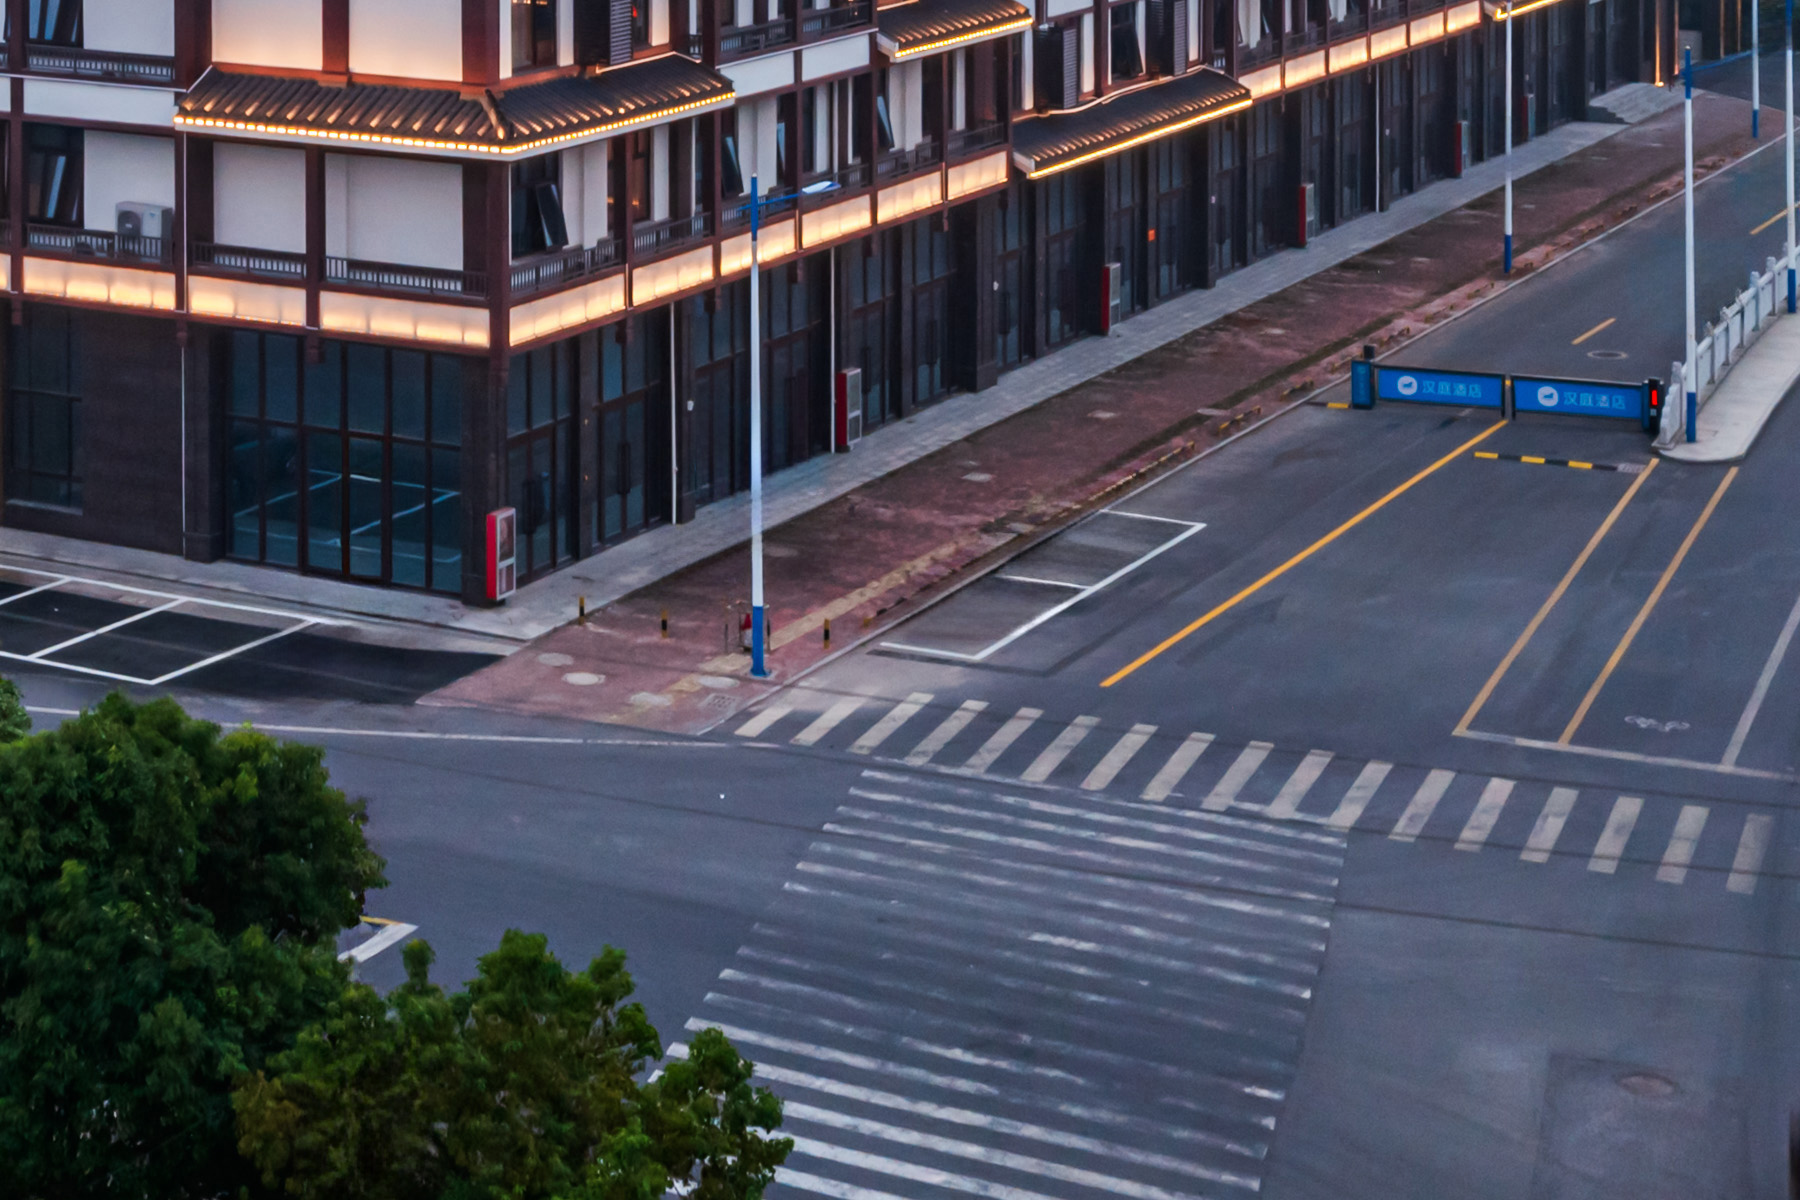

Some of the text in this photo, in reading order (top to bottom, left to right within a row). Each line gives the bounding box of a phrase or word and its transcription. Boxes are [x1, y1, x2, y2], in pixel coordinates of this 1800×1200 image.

[1422, 380, 1483, 399] 汉庭酒店
[1564, 391, 1626, 410] 汉庭酒店
